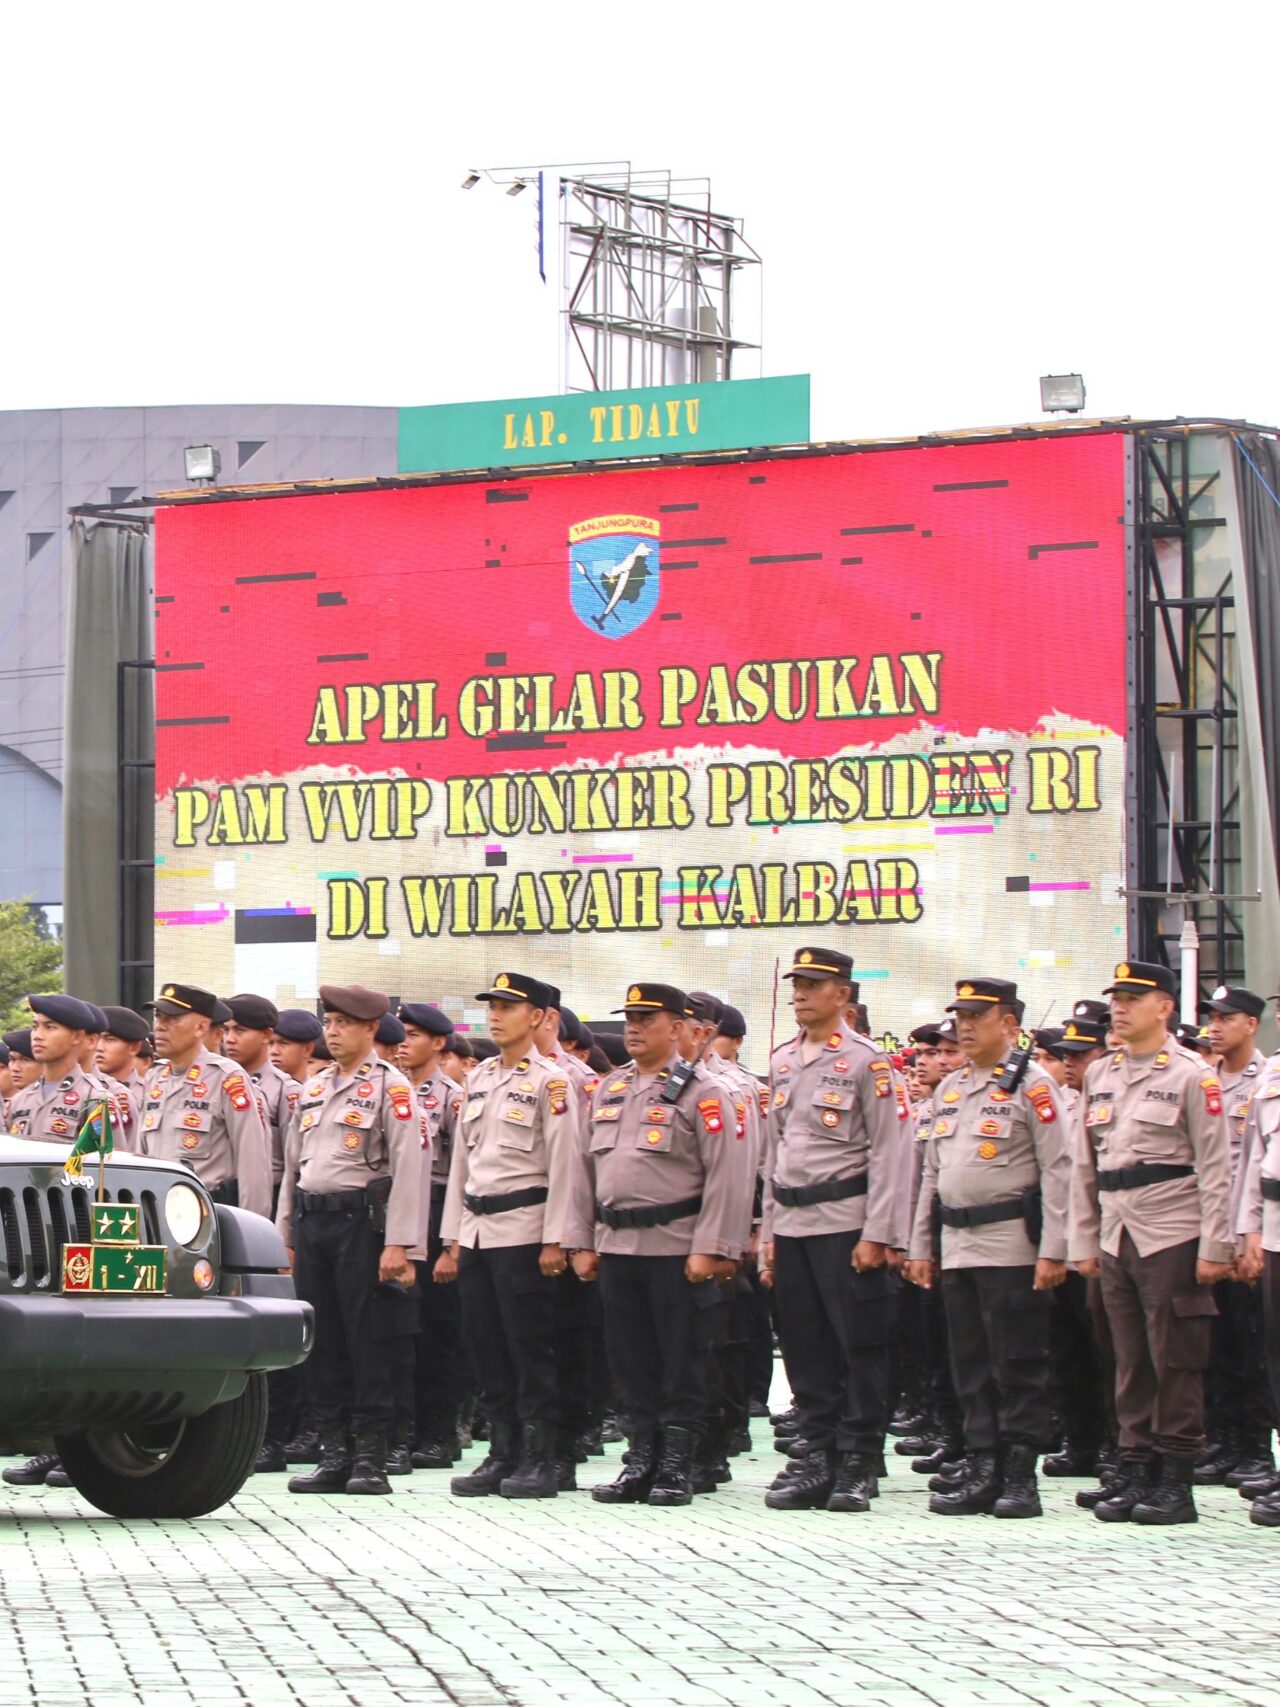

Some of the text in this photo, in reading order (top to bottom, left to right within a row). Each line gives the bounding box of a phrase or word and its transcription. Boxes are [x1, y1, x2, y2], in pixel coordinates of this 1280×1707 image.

[503, 398, 700, 449] LAP. TIDAYU
[573, 518, 654, 535] TANJUNGPURA
[306, 651, 942, 745] APEL GELAR PASUKAN
[173, 783, 288, 846] PAM
[444, 766, 694, 837] KUNKER
[706, 751, 1013, 828] PRESIDEN
[1027, 745, 1101, 814] RI
[327, 858, 924, 939] DI WILAYAH KALBAR
[183, 1100, 210, 1110] POLRI
[345, 1098, 376, 1110] POLRI
[506, 1091, 538, 1106] POLRI
[50, 1106, 79, 1118] POLRI
[980, 1106, 1011, 1116] POLRI
[60, 1171, 95, 1190] Jeep
